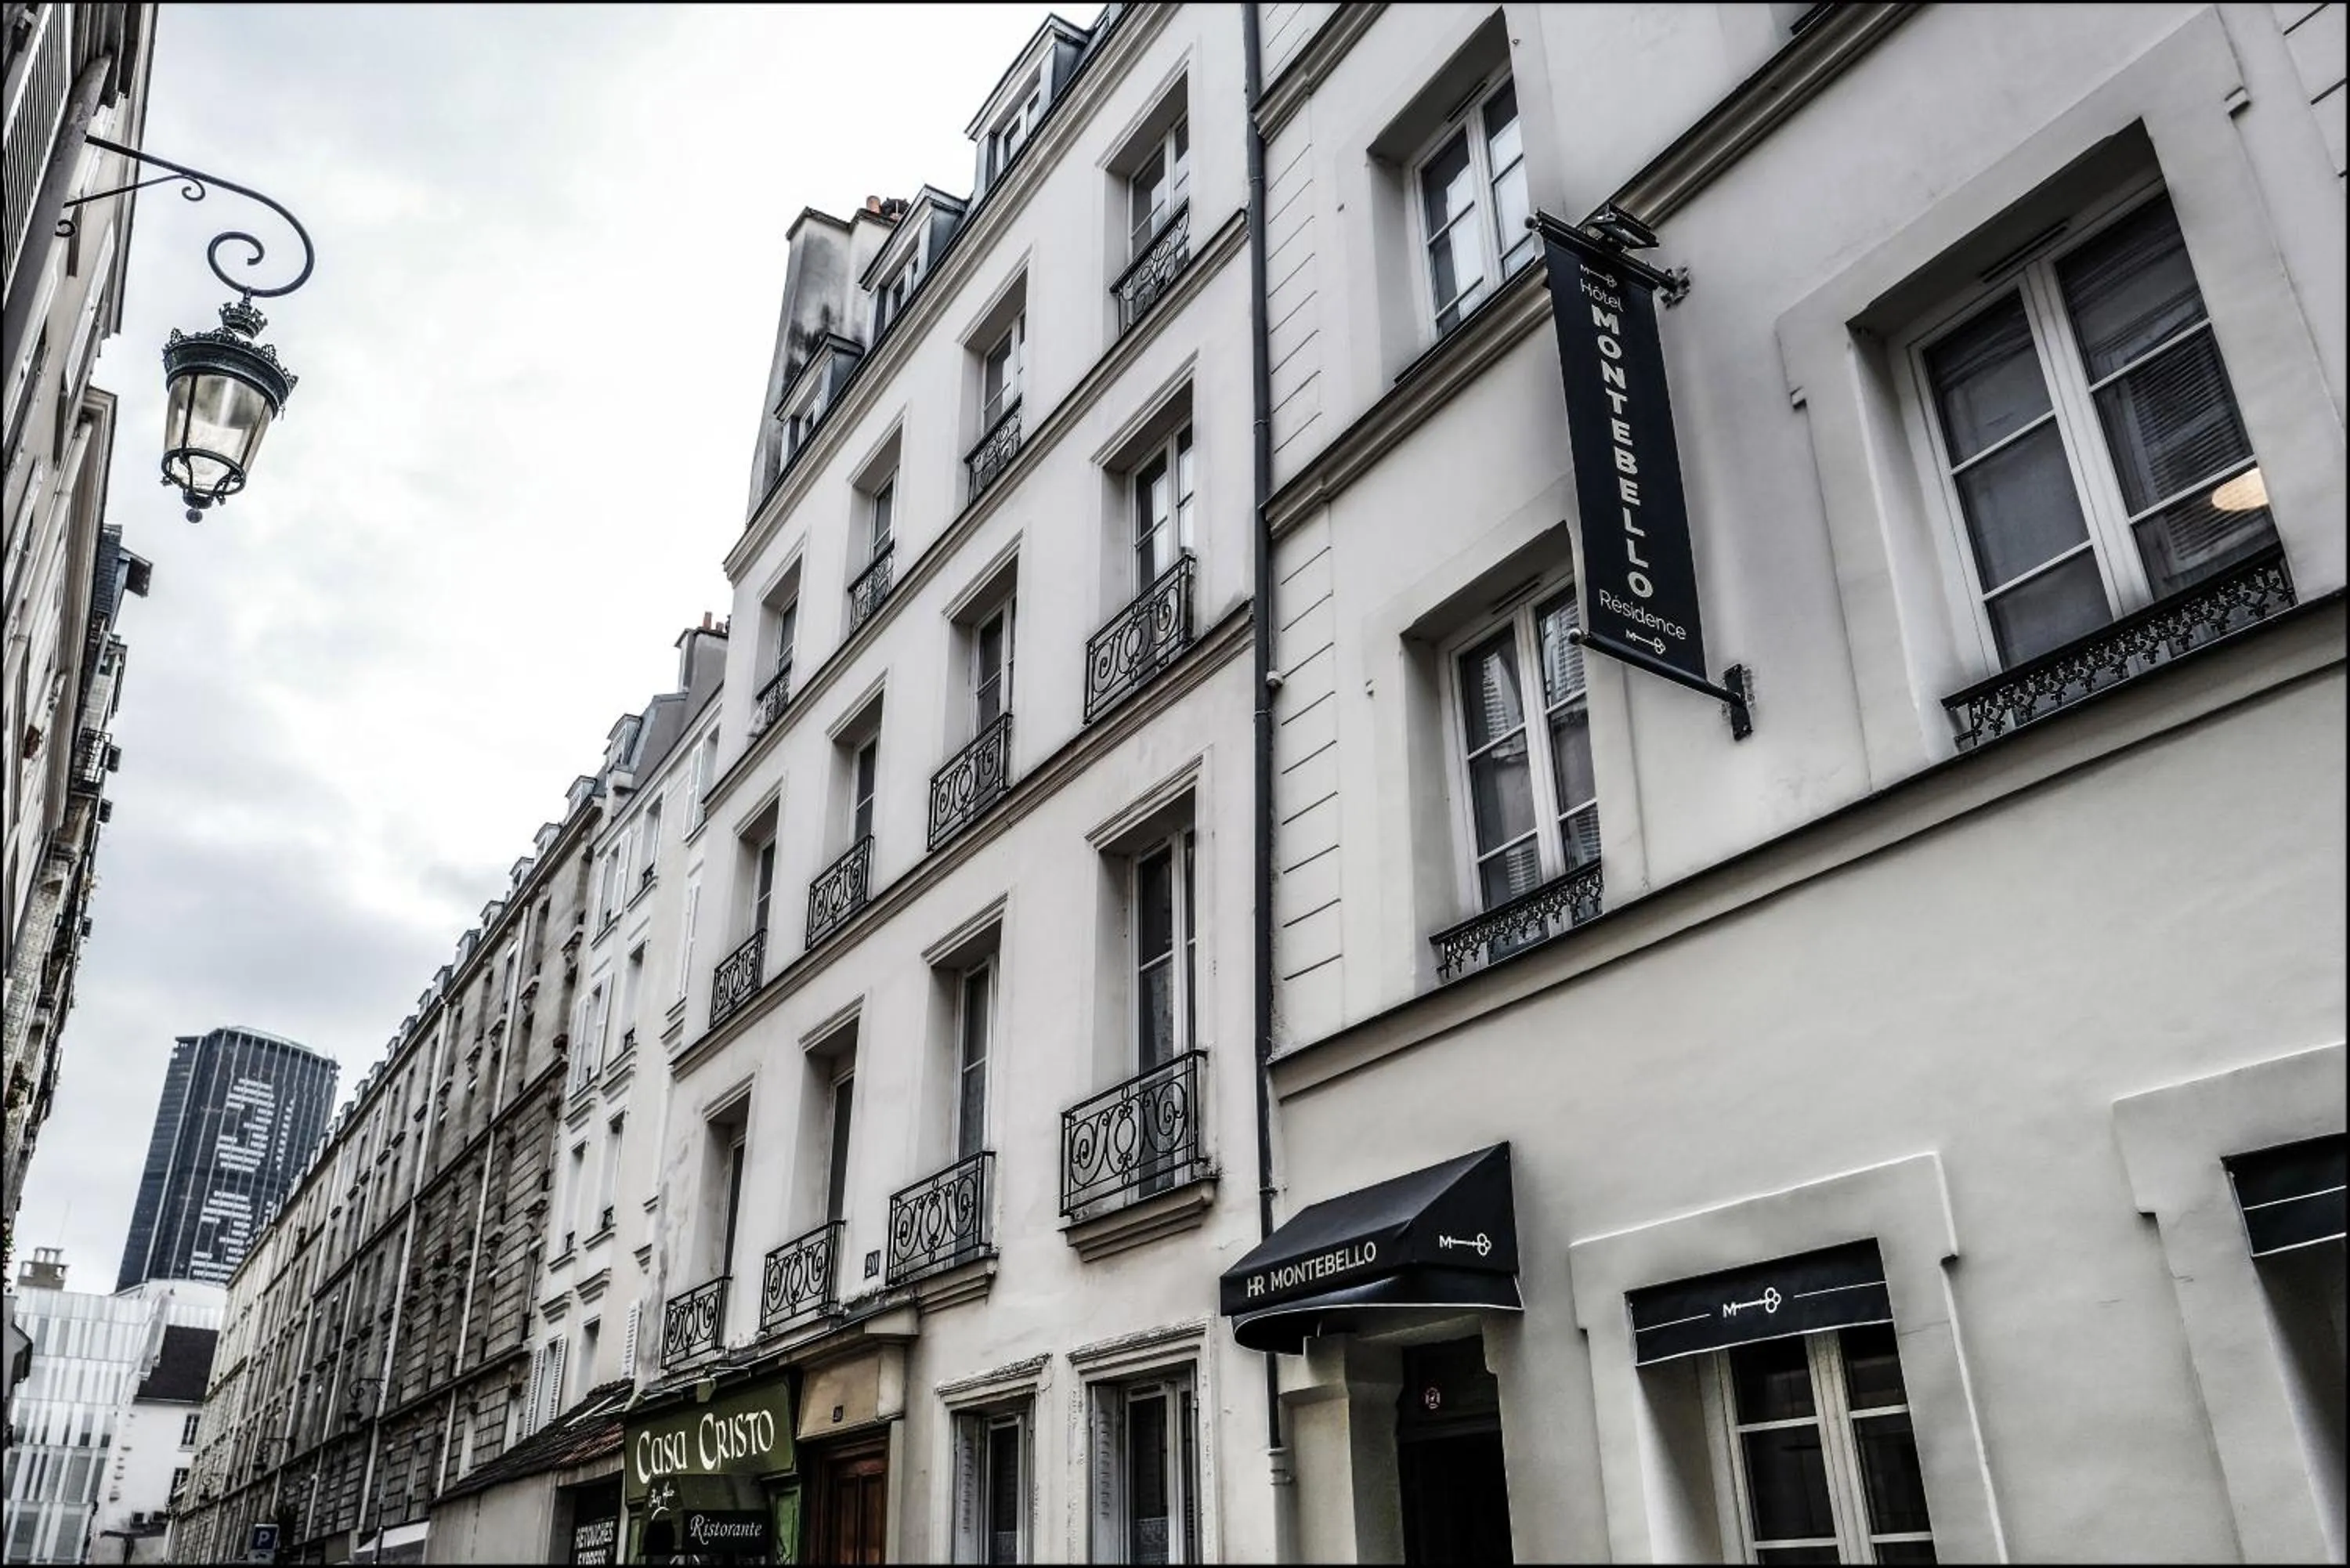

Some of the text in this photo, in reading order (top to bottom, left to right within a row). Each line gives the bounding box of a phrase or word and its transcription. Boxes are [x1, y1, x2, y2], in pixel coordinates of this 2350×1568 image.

[1580, 277, 1624, 313] Hôtel
[1591, 303, 1654, 598] MONTEBELLO
[1599, 588, 1687, 641] Résidence
[1246, 1241, 1377, 1298] HR MONTEBELLO
[636, 1409, 775, 1484] Casa CRISTO
[257, 1530, 271, 1547] P
[689, 1514, 763, 1546] Ristorante
